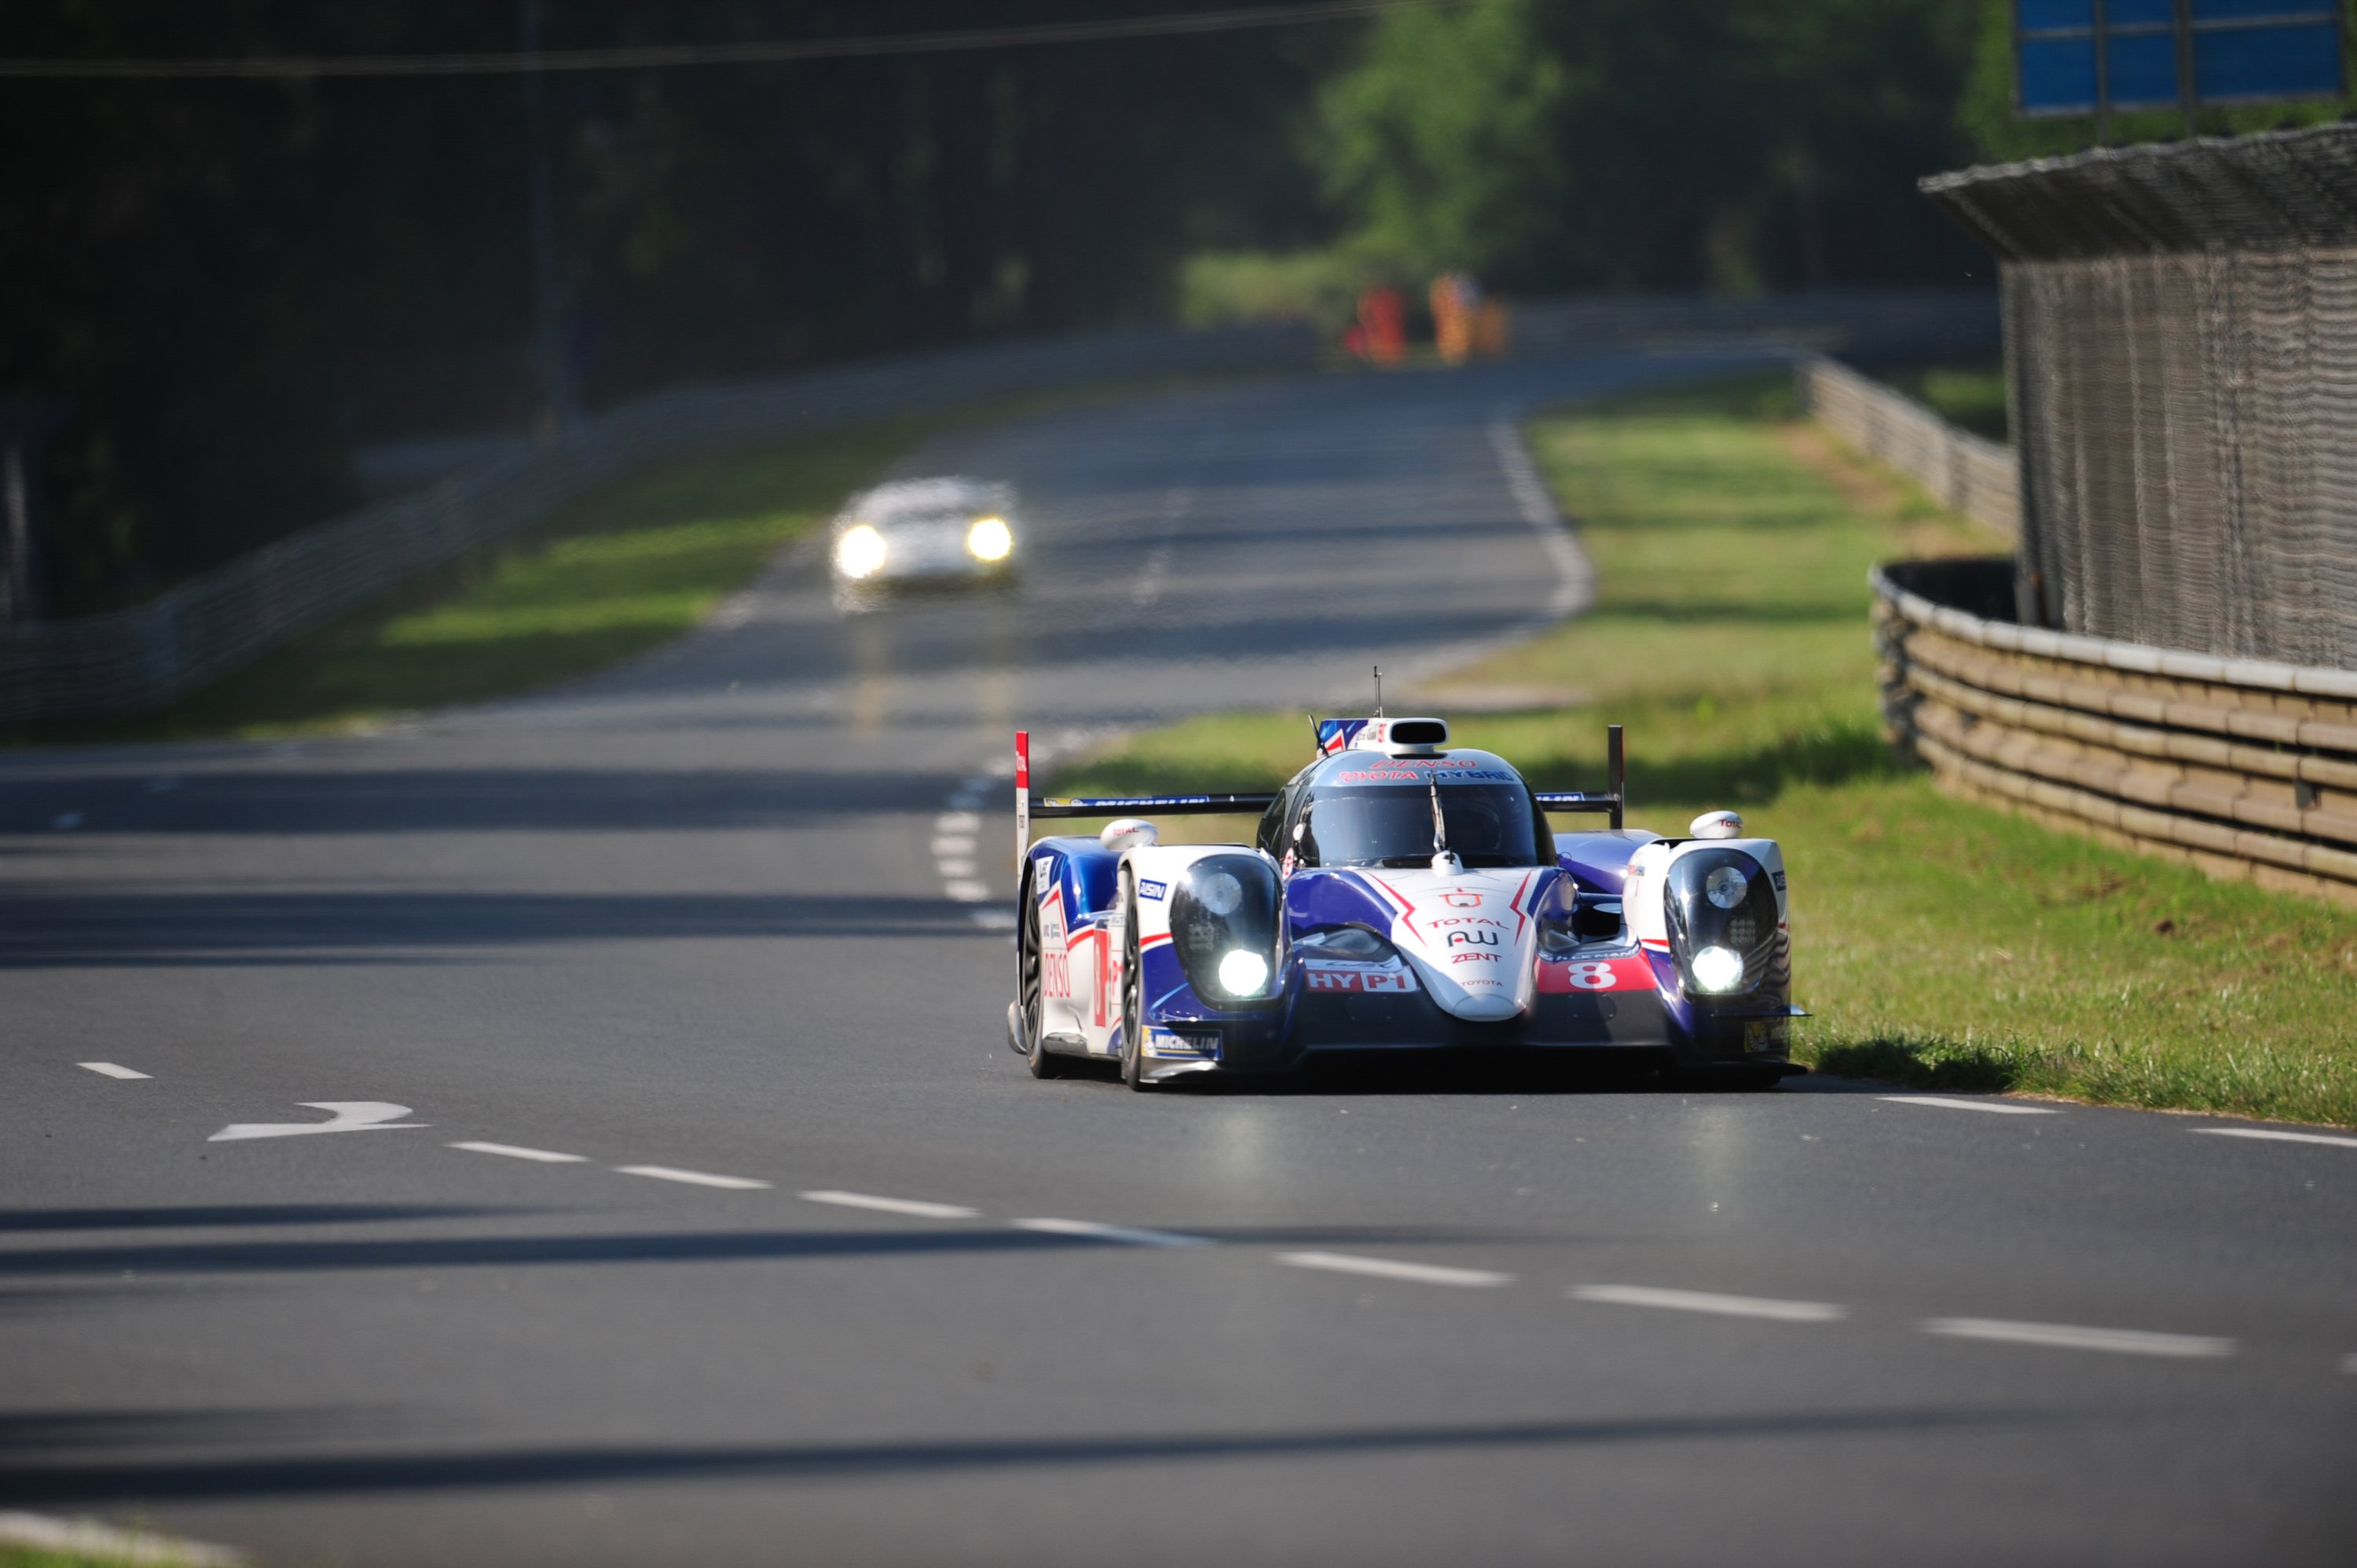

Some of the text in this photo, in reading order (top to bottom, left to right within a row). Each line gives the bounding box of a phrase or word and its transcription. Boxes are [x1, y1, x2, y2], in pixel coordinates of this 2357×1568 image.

[1369, 759, 1478, 769] DENSO
[1337, 771, 1418, 784] TOYOTA
[1113, 826, 1140, 836] TOTAL
[1140, 881, 1166, 899] AISIN
[1426, 918, 1510, 931] TOTAL
[1451, 952, 1501, 964] ZENT
[1044, 953, 1070, 998] DENSO
[1567, 962, 1617, 989] 8
[1155, 1034, 1219, 1050] MICHELIN
